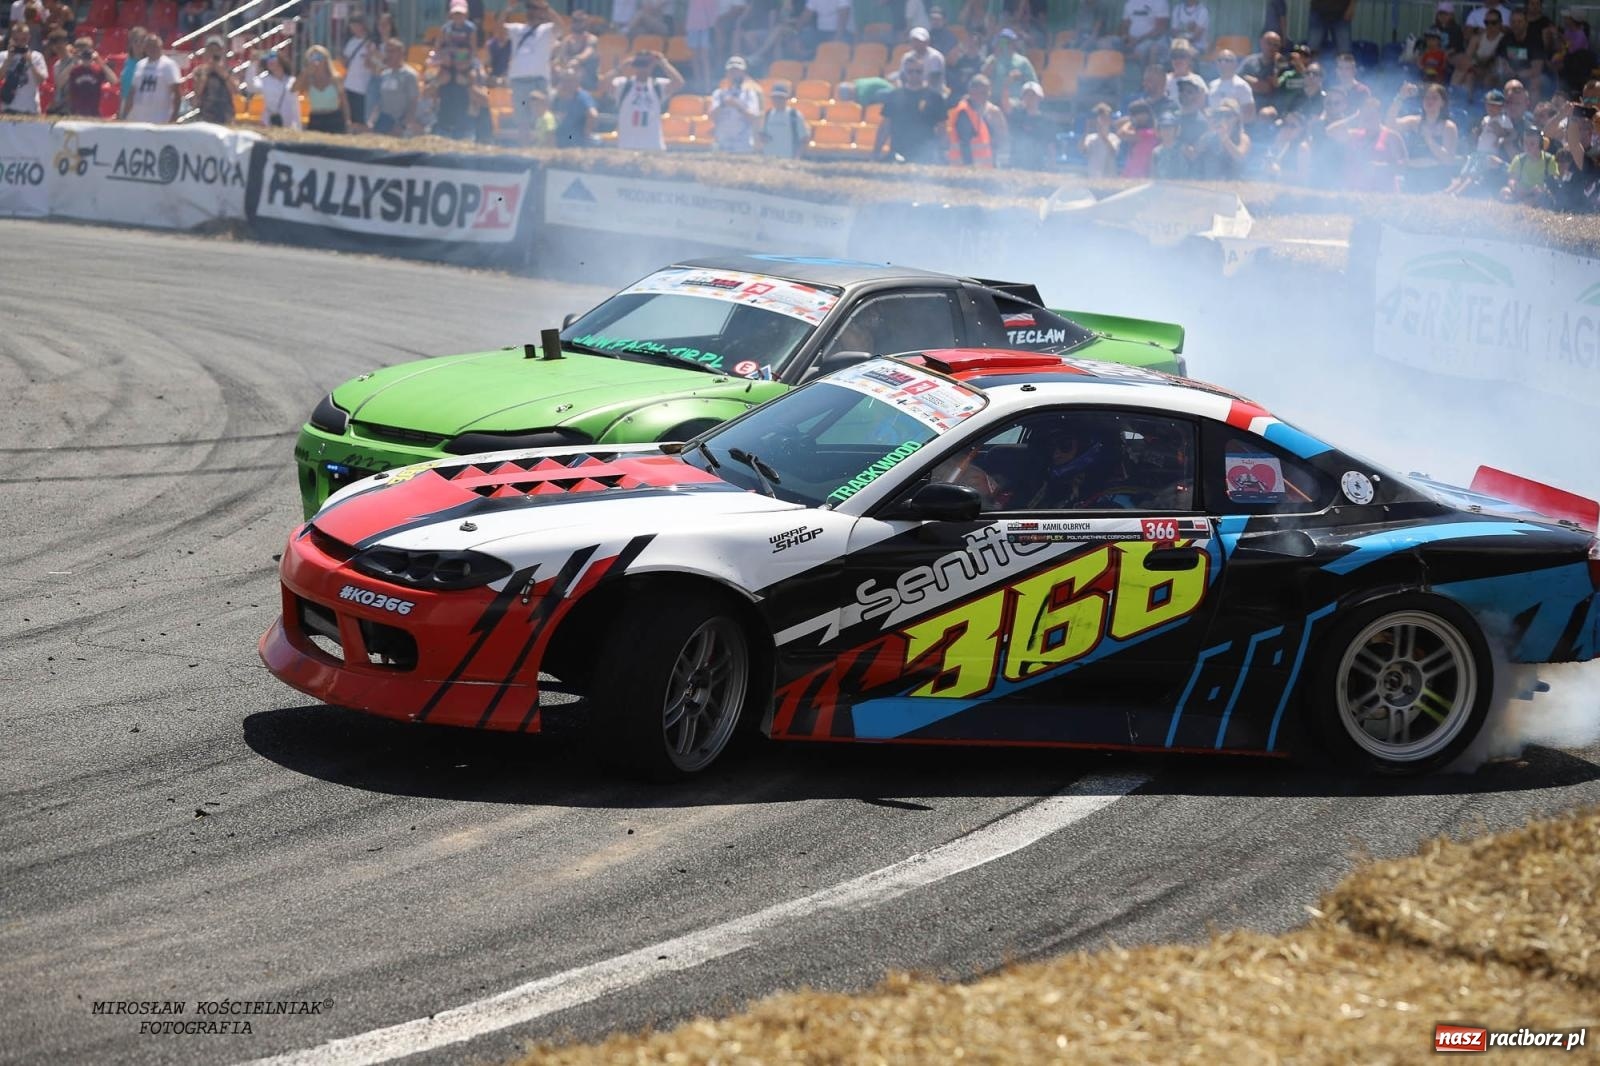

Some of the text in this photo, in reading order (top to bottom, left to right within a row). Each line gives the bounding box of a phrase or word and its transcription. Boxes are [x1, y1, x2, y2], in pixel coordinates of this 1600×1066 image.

[113, 144, 246, 188] AGRONOVA
[268, 163, 482, 229] RALLYSHOP
[1007, 328, 1067, 345] TECŁAW
[831, 440, 922, 501] TRACKWOOD
[768, 525, 808, 544] WRAP
[772, 527, 825, 554] SHOP
[1042, 522, 1063, 532] KAMIL
[1063, 522, 1091, 532] OLBRYCH
[1145, 521, 1176, 540] 366
[904, 540, 1209, 699] 366
